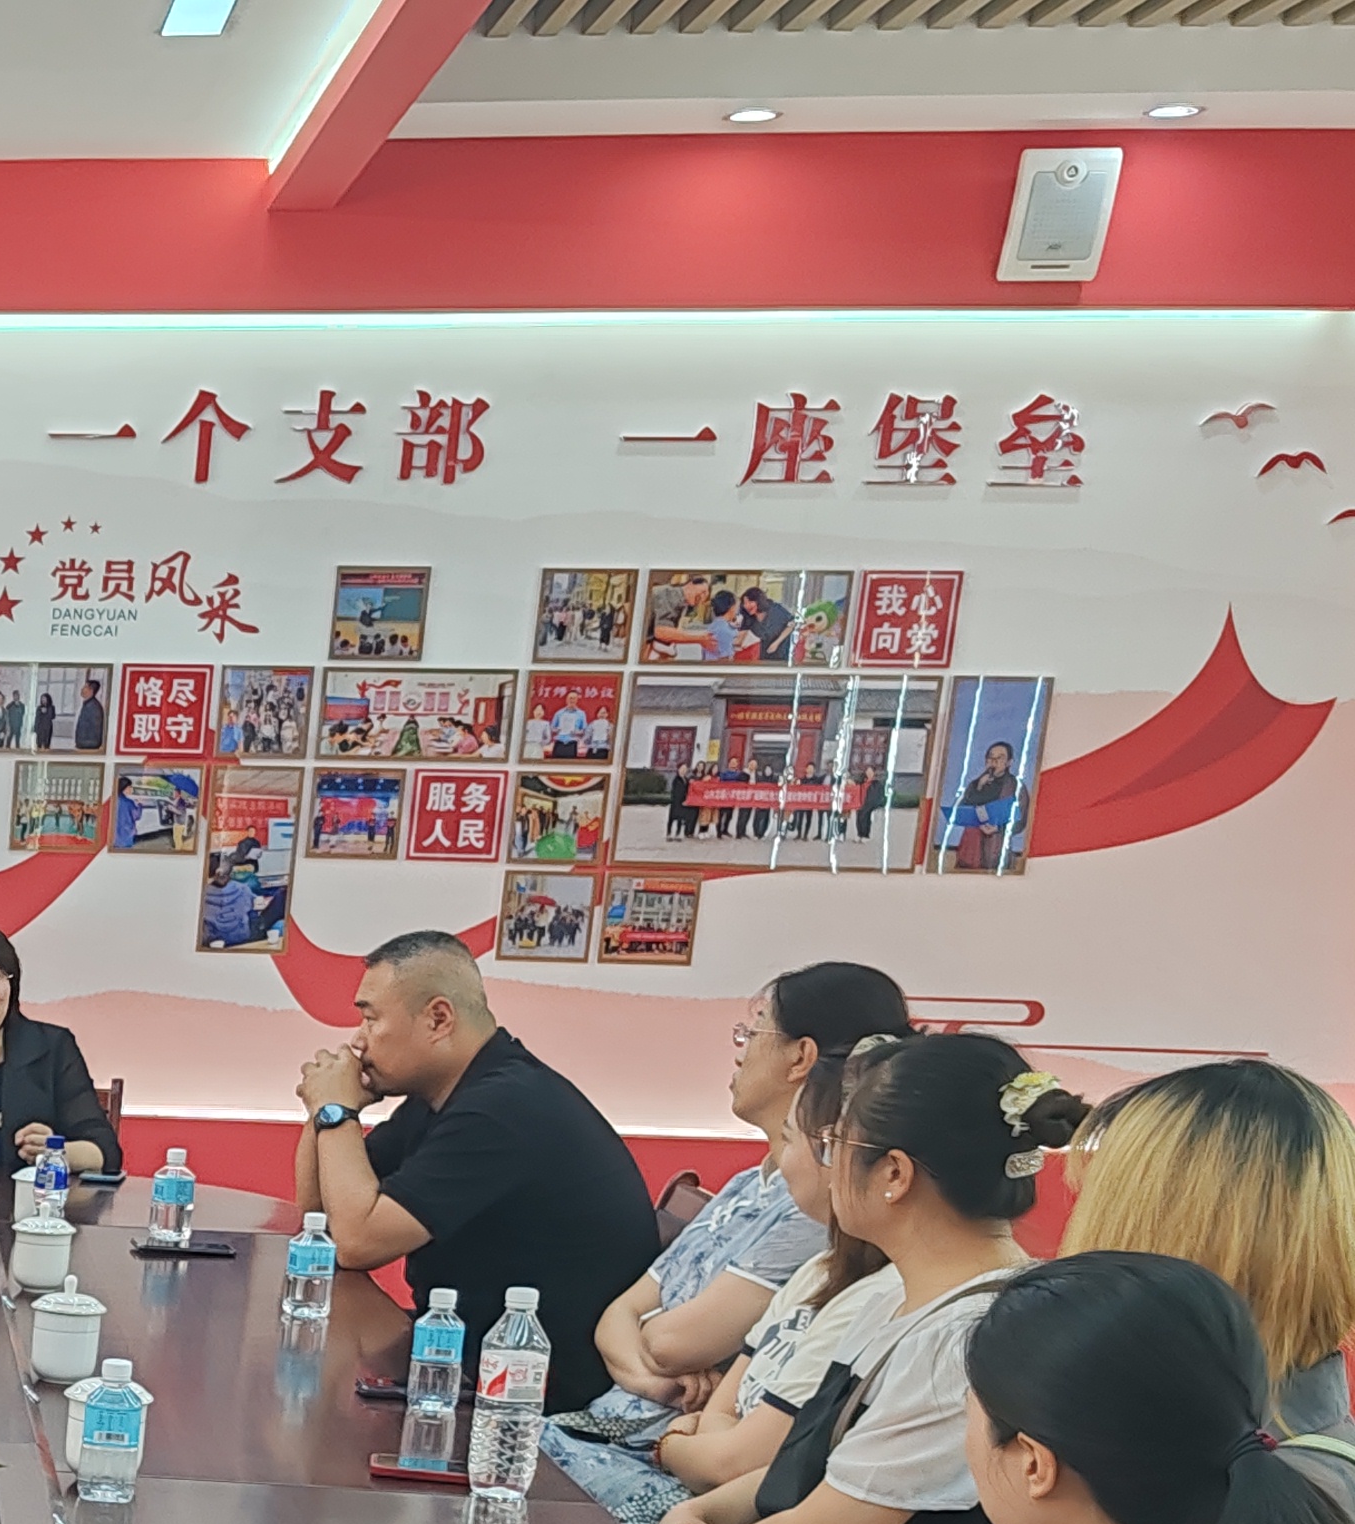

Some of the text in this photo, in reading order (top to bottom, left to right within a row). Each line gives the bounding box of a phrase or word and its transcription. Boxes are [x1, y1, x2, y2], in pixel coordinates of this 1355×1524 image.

[47, 388, 1087, 487] 一个支部 一座堡垒
[49, 550, 260, 644] 党员风采
[875, 584, 944, 616] 我心
[52, 607, 138, 622] DANGYUAN
[50, 624, 119, 637] FENGCAI
[869, 622, 939, 654] 向党
[135, 676, 198, 708] 恪尽
[131, 713, 195, 744] 职守
[425, 782, 492, 813] 服务
[421, 819, 486, 849] 人民
